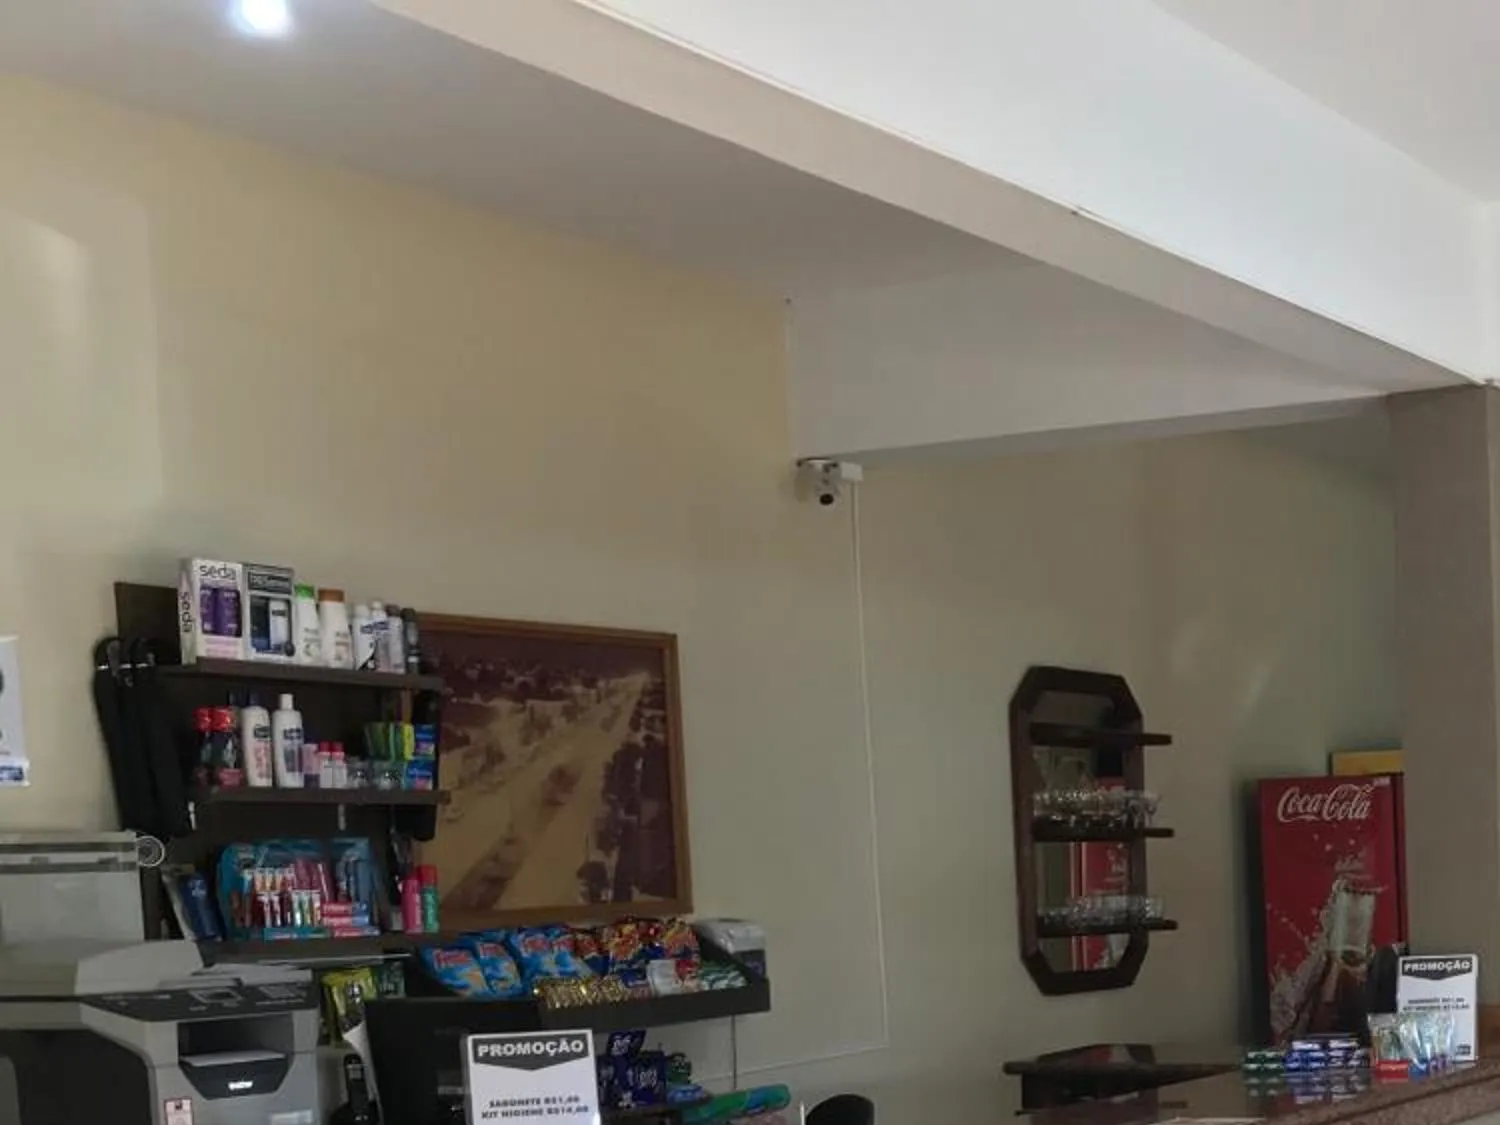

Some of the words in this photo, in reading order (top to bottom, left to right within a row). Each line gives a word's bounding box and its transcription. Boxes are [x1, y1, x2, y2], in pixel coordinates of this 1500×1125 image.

[199, 564, 237, 580] seda
[1277, 783, 1374, 824] Coca-Cola
[1403, 960, 1470, 972] PROMOÇÃO
[478, 1038, 584, 1057] PROMOÇÃO
